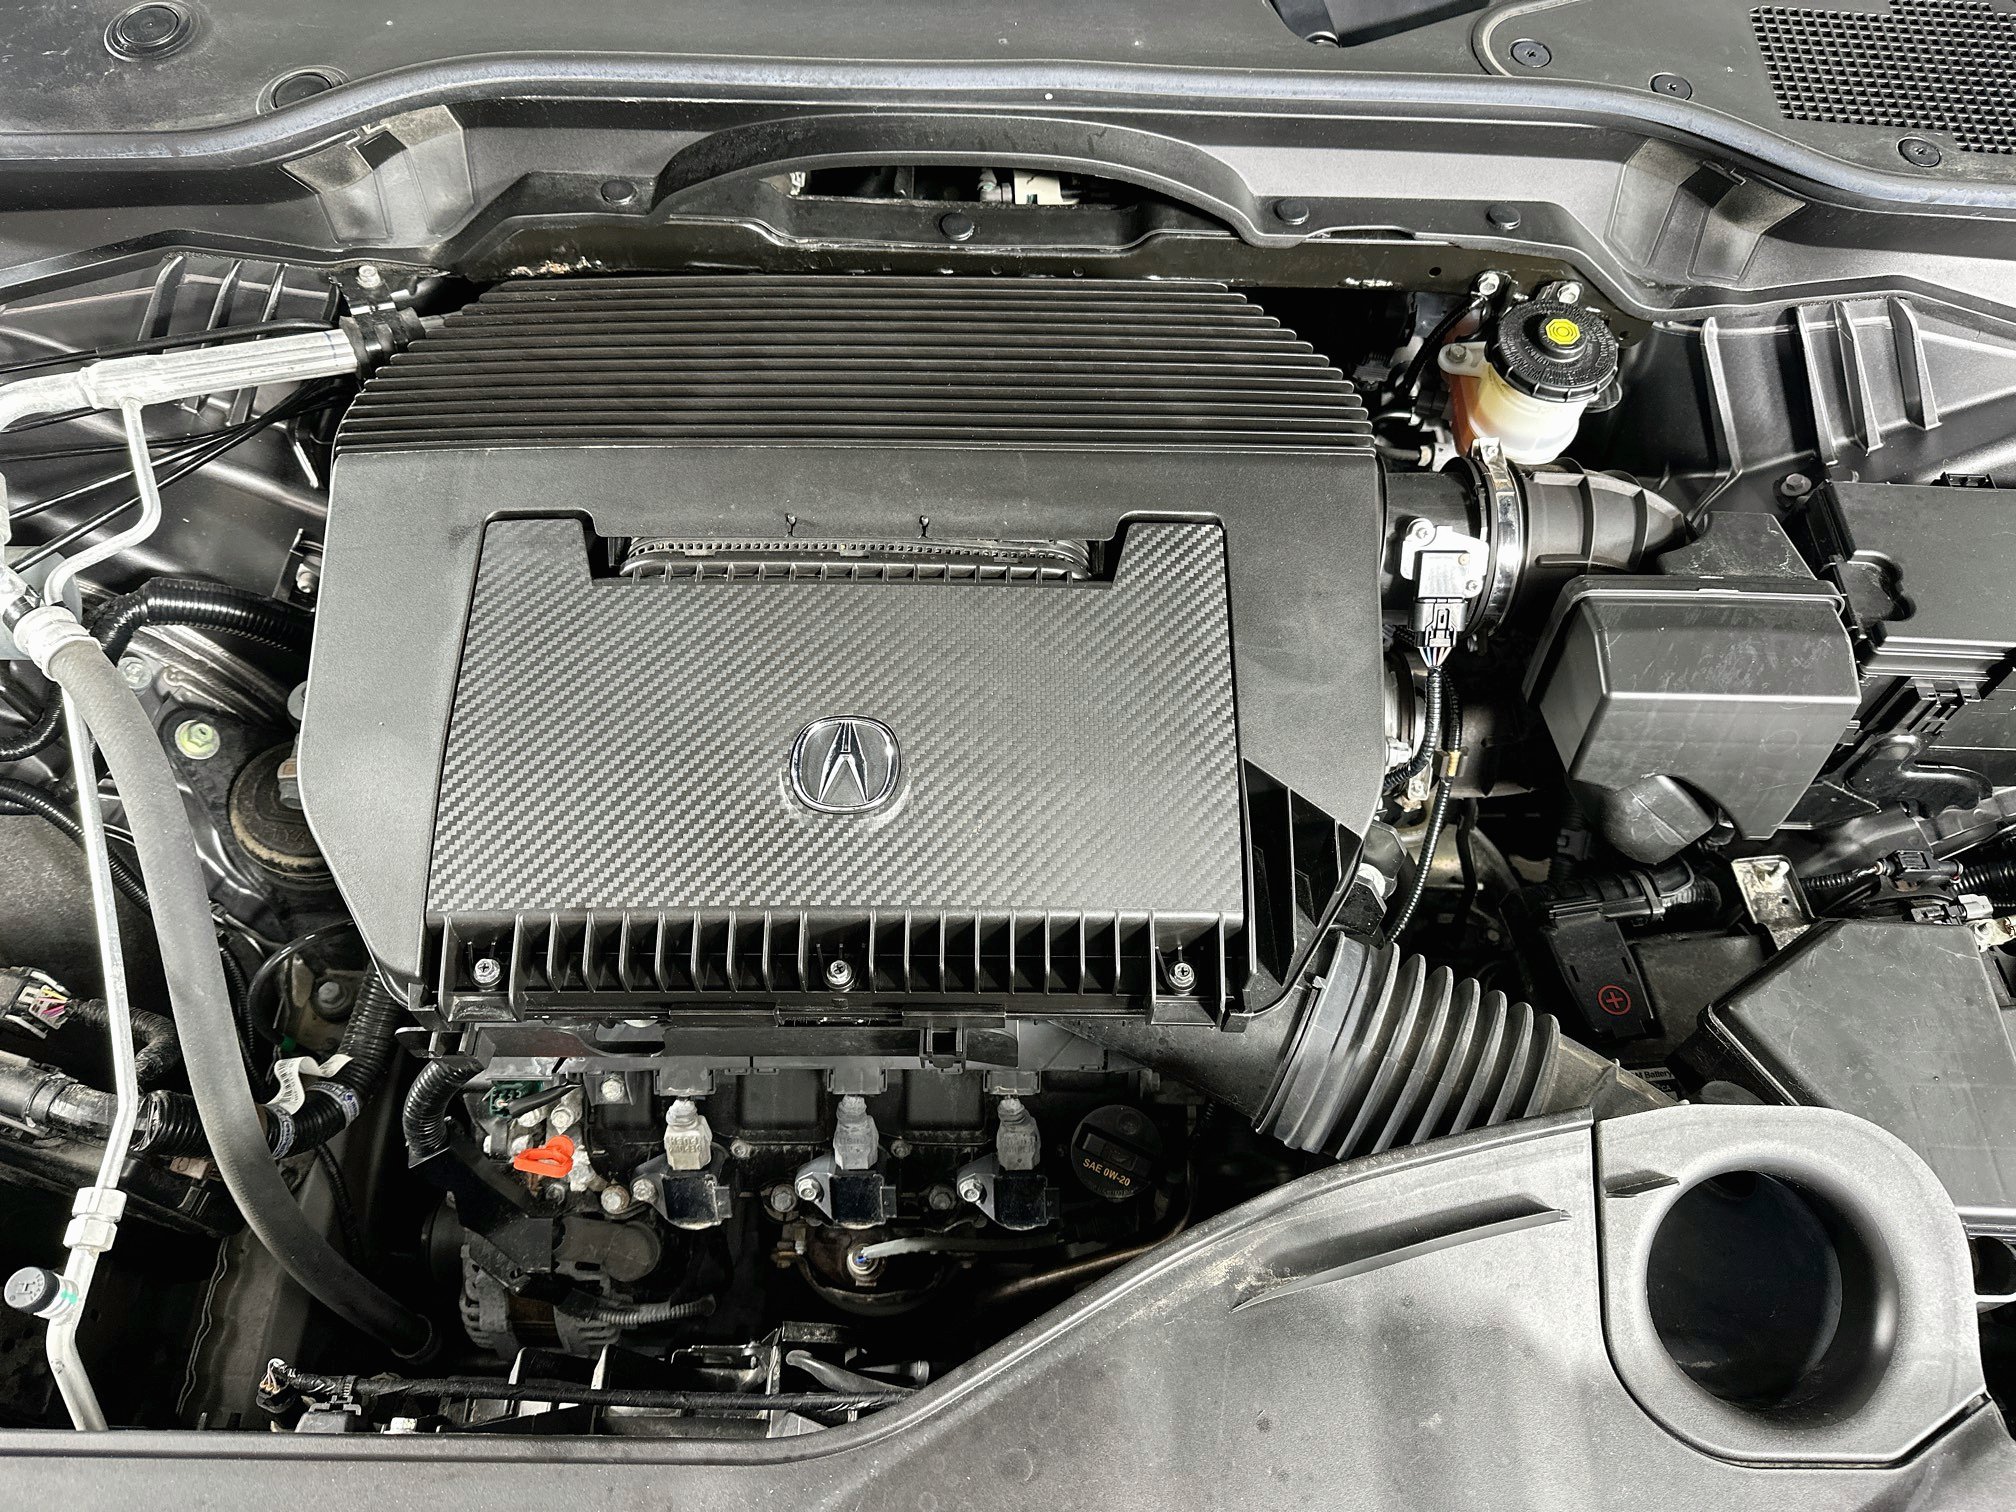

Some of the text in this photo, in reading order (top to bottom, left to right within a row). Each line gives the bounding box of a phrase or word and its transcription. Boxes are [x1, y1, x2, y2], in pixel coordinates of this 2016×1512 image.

[1644, 1070, 1672, 1079] Battery
[1082, 1158, 1131, 1187] SAE 0W-20
